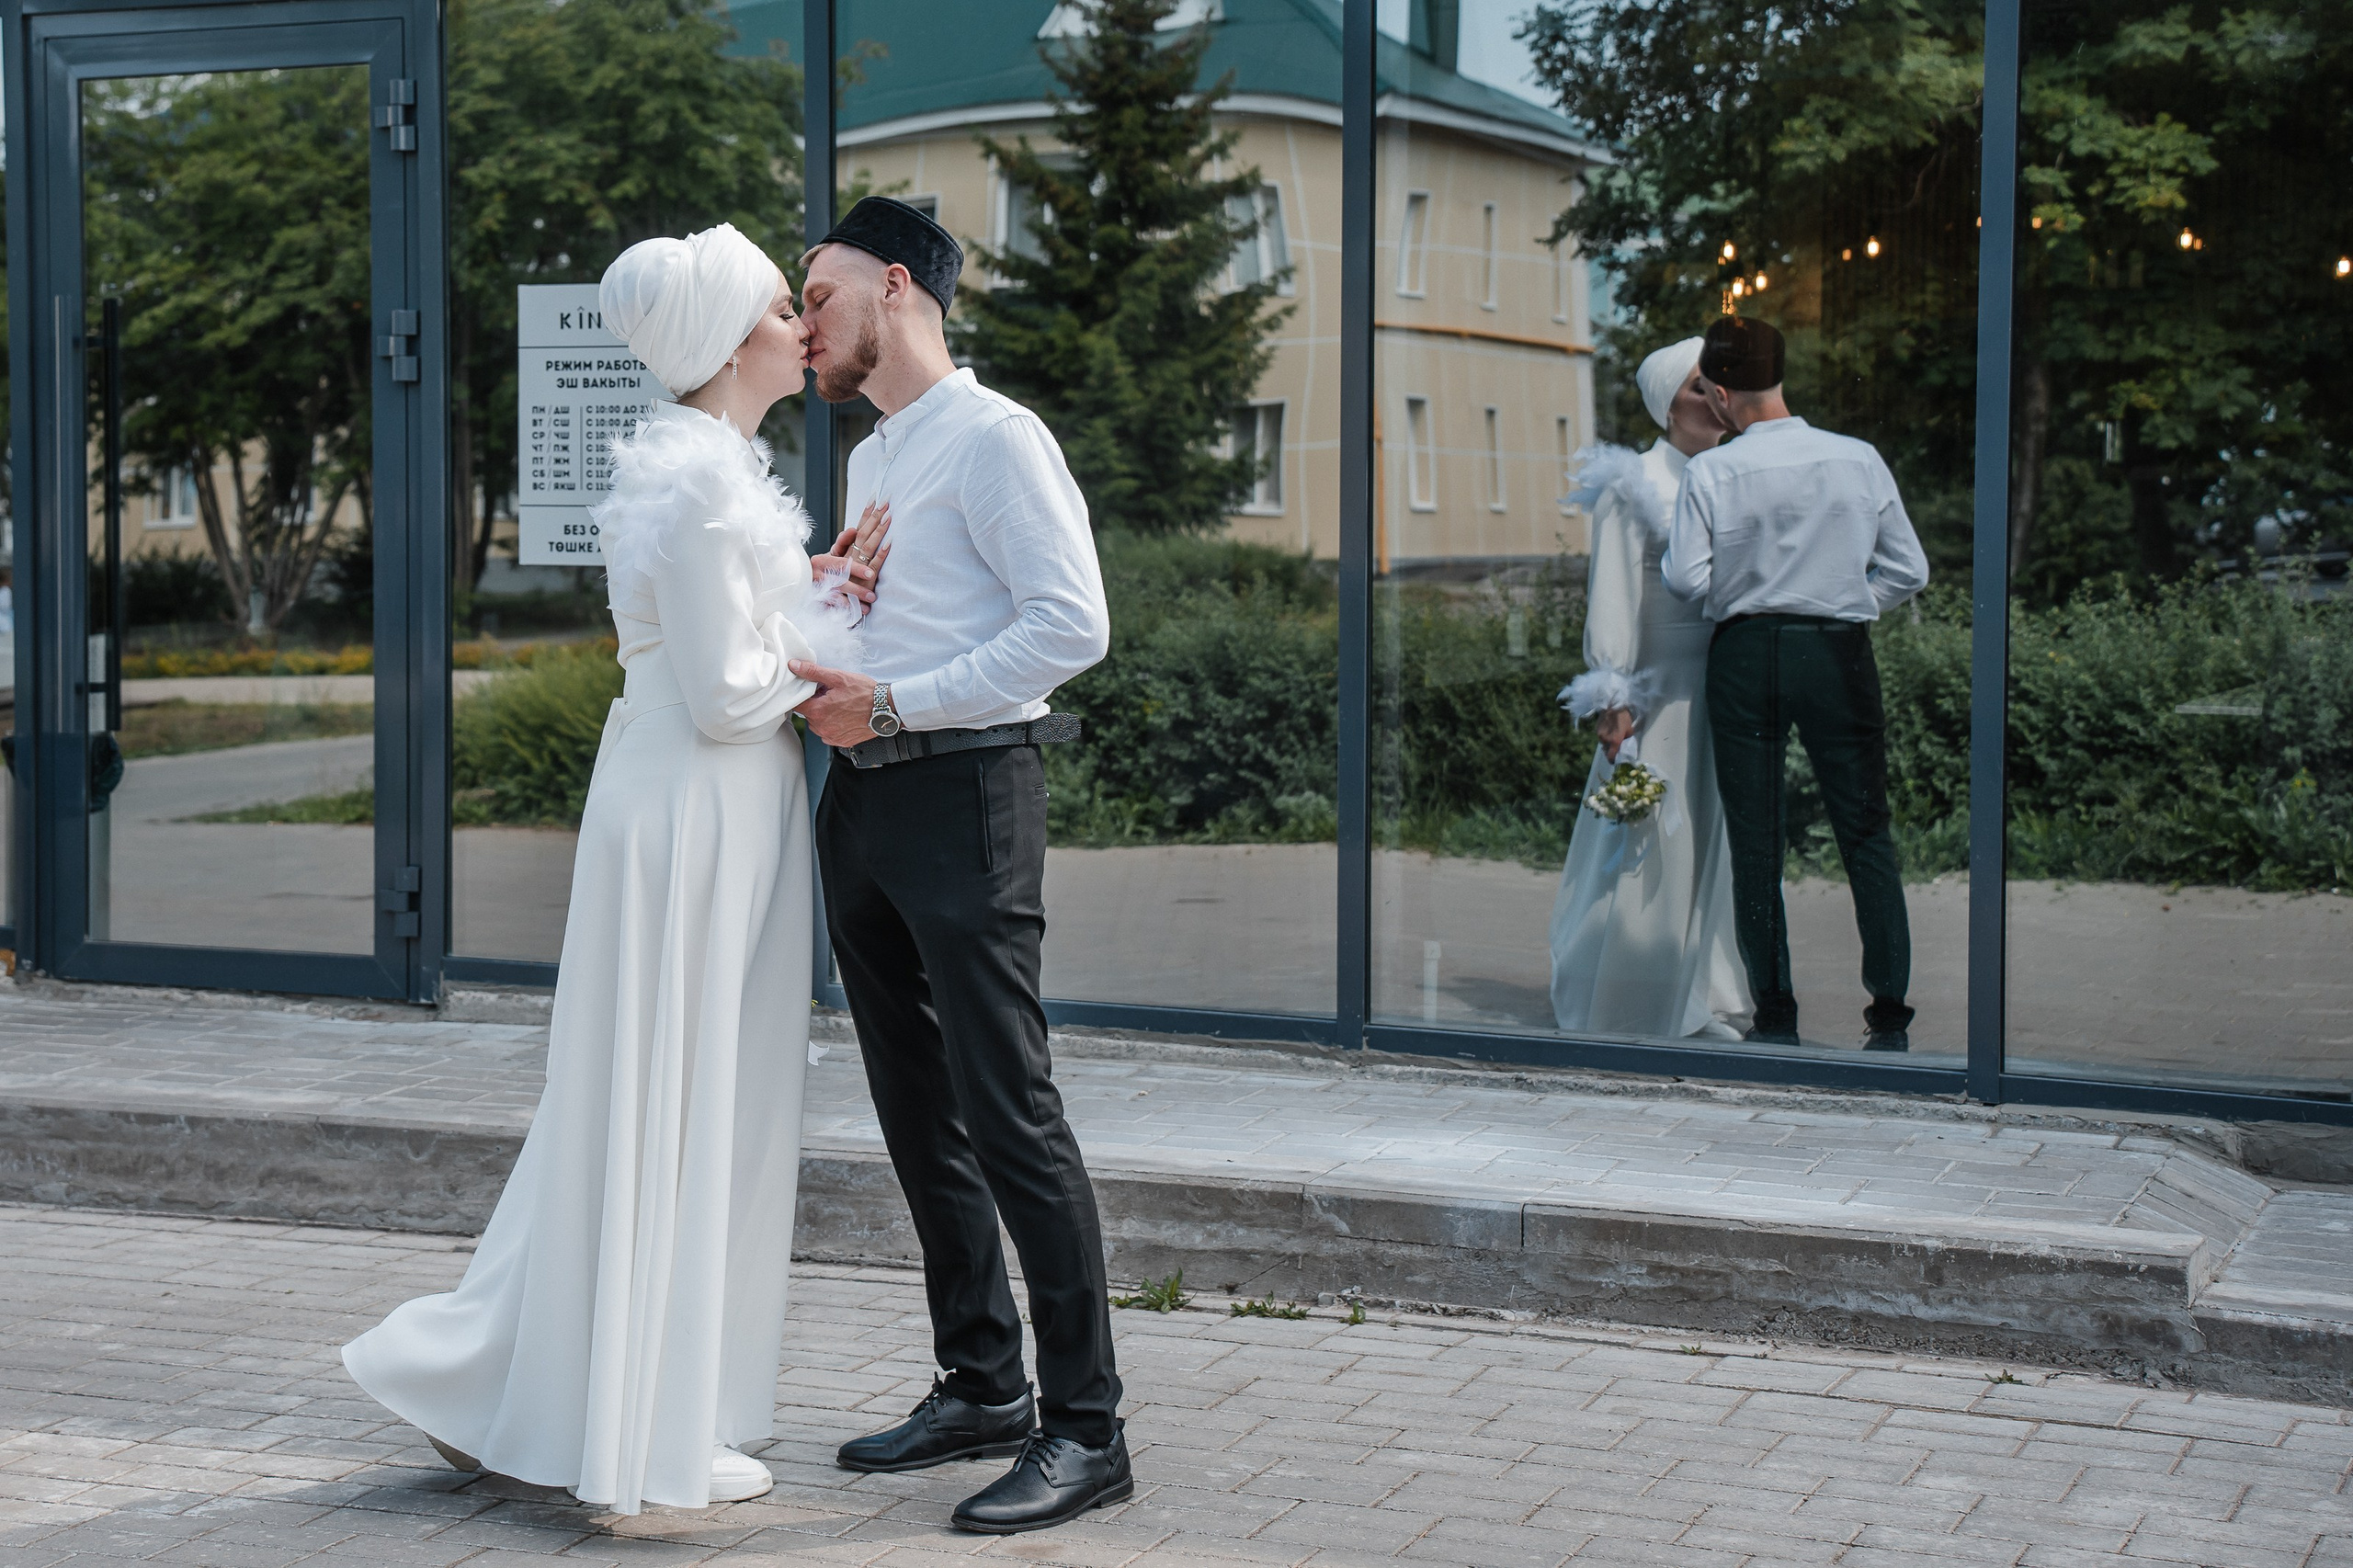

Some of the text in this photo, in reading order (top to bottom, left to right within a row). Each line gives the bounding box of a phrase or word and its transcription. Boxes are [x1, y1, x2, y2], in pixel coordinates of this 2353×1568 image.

[560, 306, 601, 330] KÎN
[546, 359, 592, 371] РЕЖИМ
[556, 377, 641, 389] ЭШ ВАКЫТЫ
[563, 524, 586, 535] БЕЗ
[549, 540, 593, 552] ТӨШКЕ
